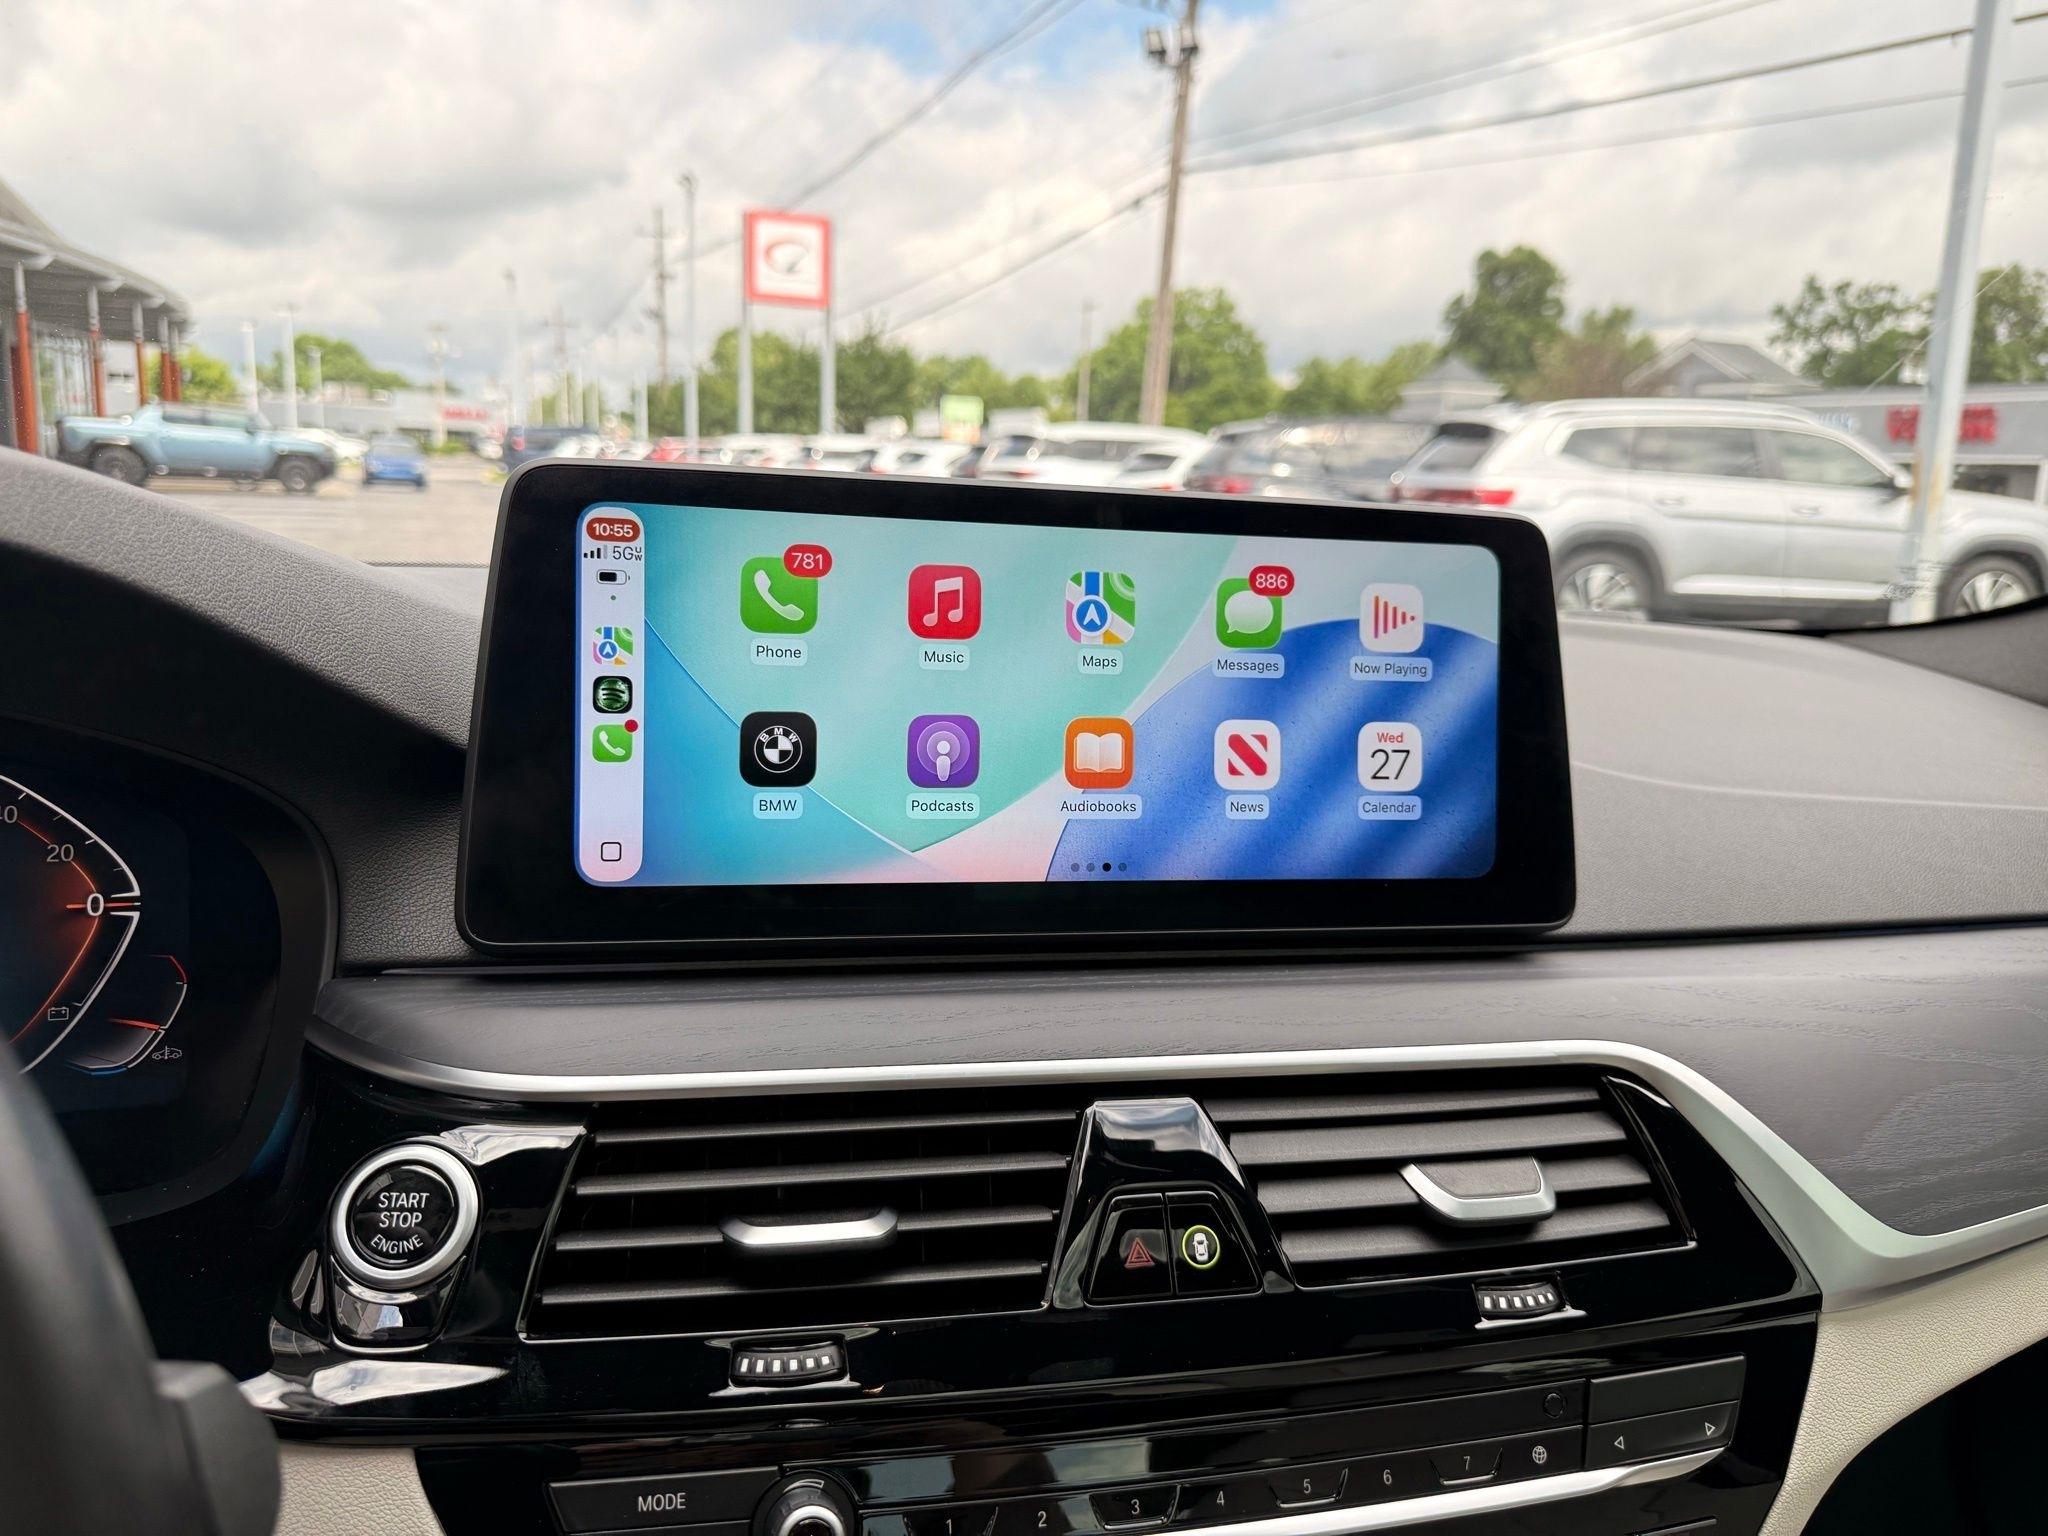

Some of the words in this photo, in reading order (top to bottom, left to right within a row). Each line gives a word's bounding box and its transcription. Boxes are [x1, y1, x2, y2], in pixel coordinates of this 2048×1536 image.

[592, 523, 633, 537] 10:55
[792, 553, 824, 570] 781
[1256, 574, 1287, 589] 886
[756, 645, 801, 659] Phone
[924, 651, 964, 664] Music
[1082, 656, 1117, 669] Maps
[1217, 659, 1279, 674] Messages
[1354, 662, 1380, 674] Now
[1385, 663, 1427, 678] Playing
[760, 728, 798, 743] BMW
[1377, 732, 1403, 743] Wed
[1370, 749, 1410, 780] 27
[759, 799, 797, 812] BMW
[912, 799, 974, 812] Podcasts
[1061, 800, 1136, 813] Audiobooks
[1230, 801, 1263, 813] News
[1363, 801, 1416, 813] Calendar
[0, 806, 18, 823] 0
[46, 844, 74, 862] 20
[87, 893, 104, 916] 0
[379, 1192, 429, 1208] START
[380, 1211, 422, 1227] STOP
[370, 1234, 423, 1254] ENGINE
[1463, 1456, 1471, 1471] 7
[1383, 1470, 1392, 1485] 6
[1303, 1478, 1312, 1494] 5
[638, 1493, 685, 1511] MODE
[1216, 1491, 1225, 1506] 4
[1131, 1500, 1140, 1514] 3
[1037, 1511, 1047, 1526] 2
[945, 1518, 952, 1535] 1
